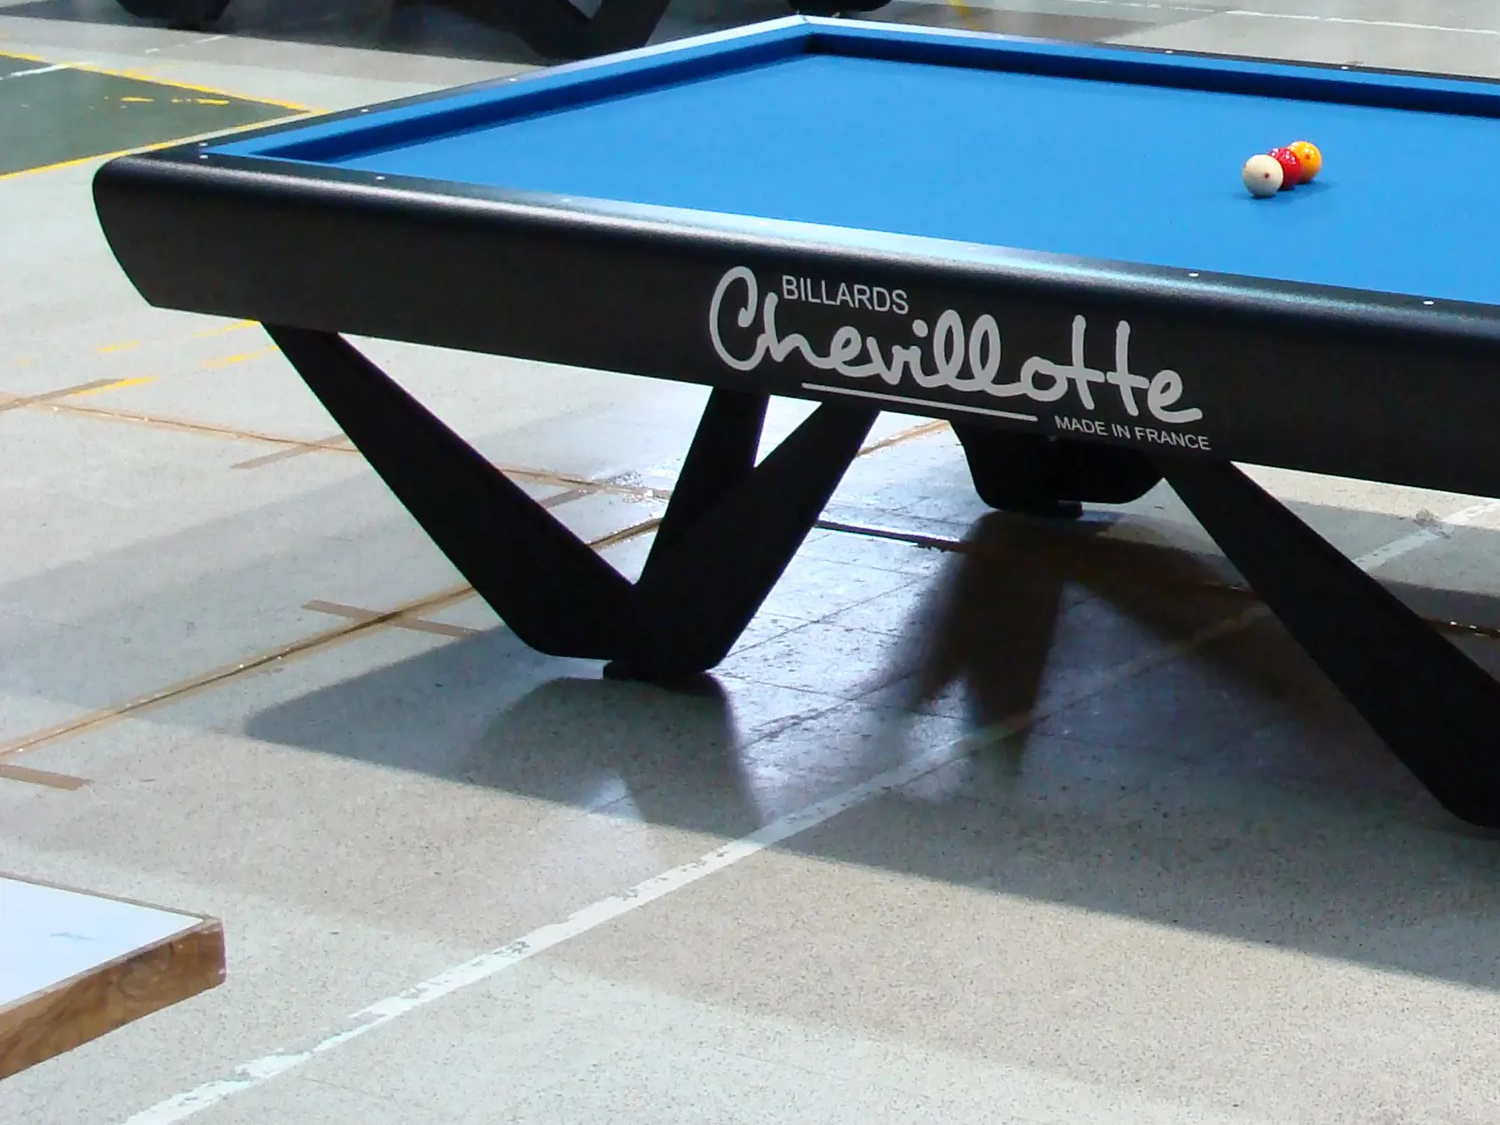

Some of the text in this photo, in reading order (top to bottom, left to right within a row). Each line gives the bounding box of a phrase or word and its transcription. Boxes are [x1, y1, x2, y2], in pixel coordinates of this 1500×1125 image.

[782, 274, 909, 314] BILLARDS
[709, 265, 1203, 424] Chevillotte
[1054, 415, 1212, 451] MADE IN FRANCE
